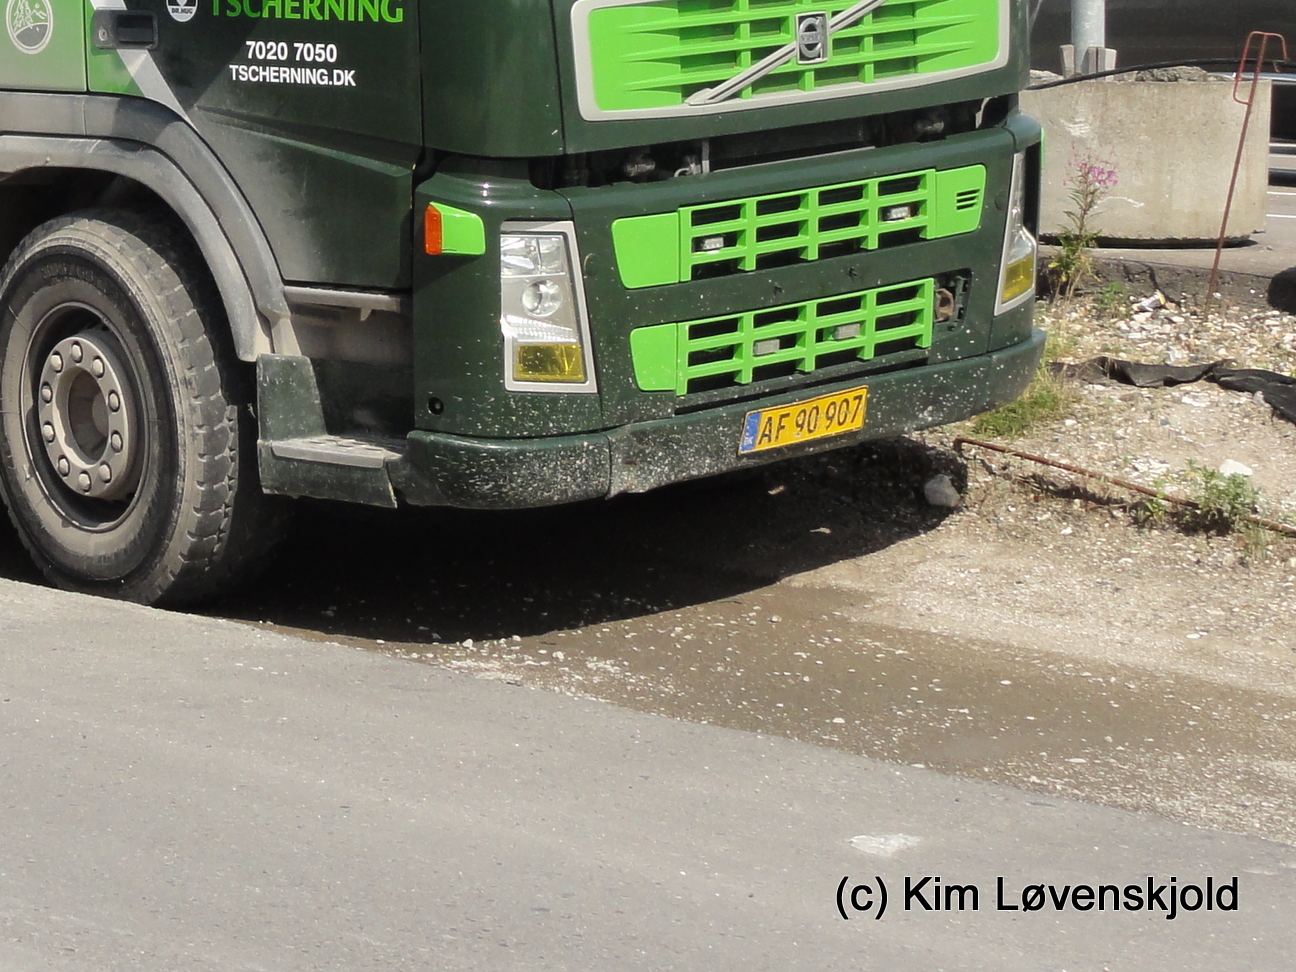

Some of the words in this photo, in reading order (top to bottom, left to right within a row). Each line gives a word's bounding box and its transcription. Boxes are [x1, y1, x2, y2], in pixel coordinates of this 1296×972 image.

[246, 40, 289, 61] 7020
[293, 43, 337, 63] 7050
[229, 64, 356, 87] TSCHERNING.DK
[757, 413, 790, 445] AF
[795, 404, 820, 435] 90
[825, 394, 864, 431] 907
